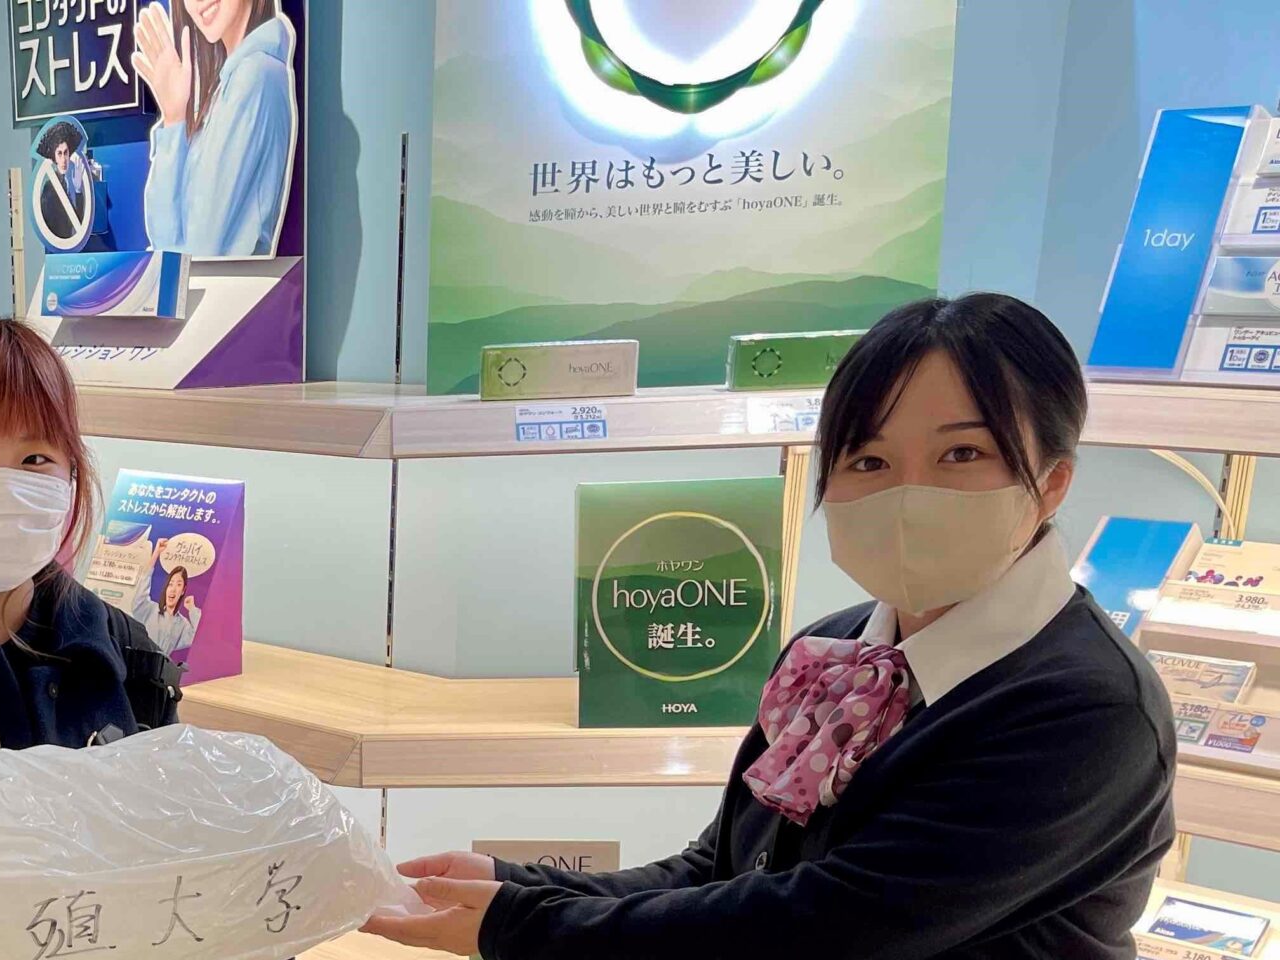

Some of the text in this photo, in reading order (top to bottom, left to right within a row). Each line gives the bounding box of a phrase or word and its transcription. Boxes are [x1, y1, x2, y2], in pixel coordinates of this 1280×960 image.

[19, 23, 131, 99] ストレス
[529, 149, 845, 197] 世界はもっと美しい。
[1143, 228, 1195, 250] 1day
[127, 482, 216, 504] あなたをコンタクトの
[656, 560, 705, 573] ホヤワン
[613, 578, 748, 614] hoyaONE
[647, 622, 716, 650] 誕生。
[662, 703, 698, 713] HOYA
